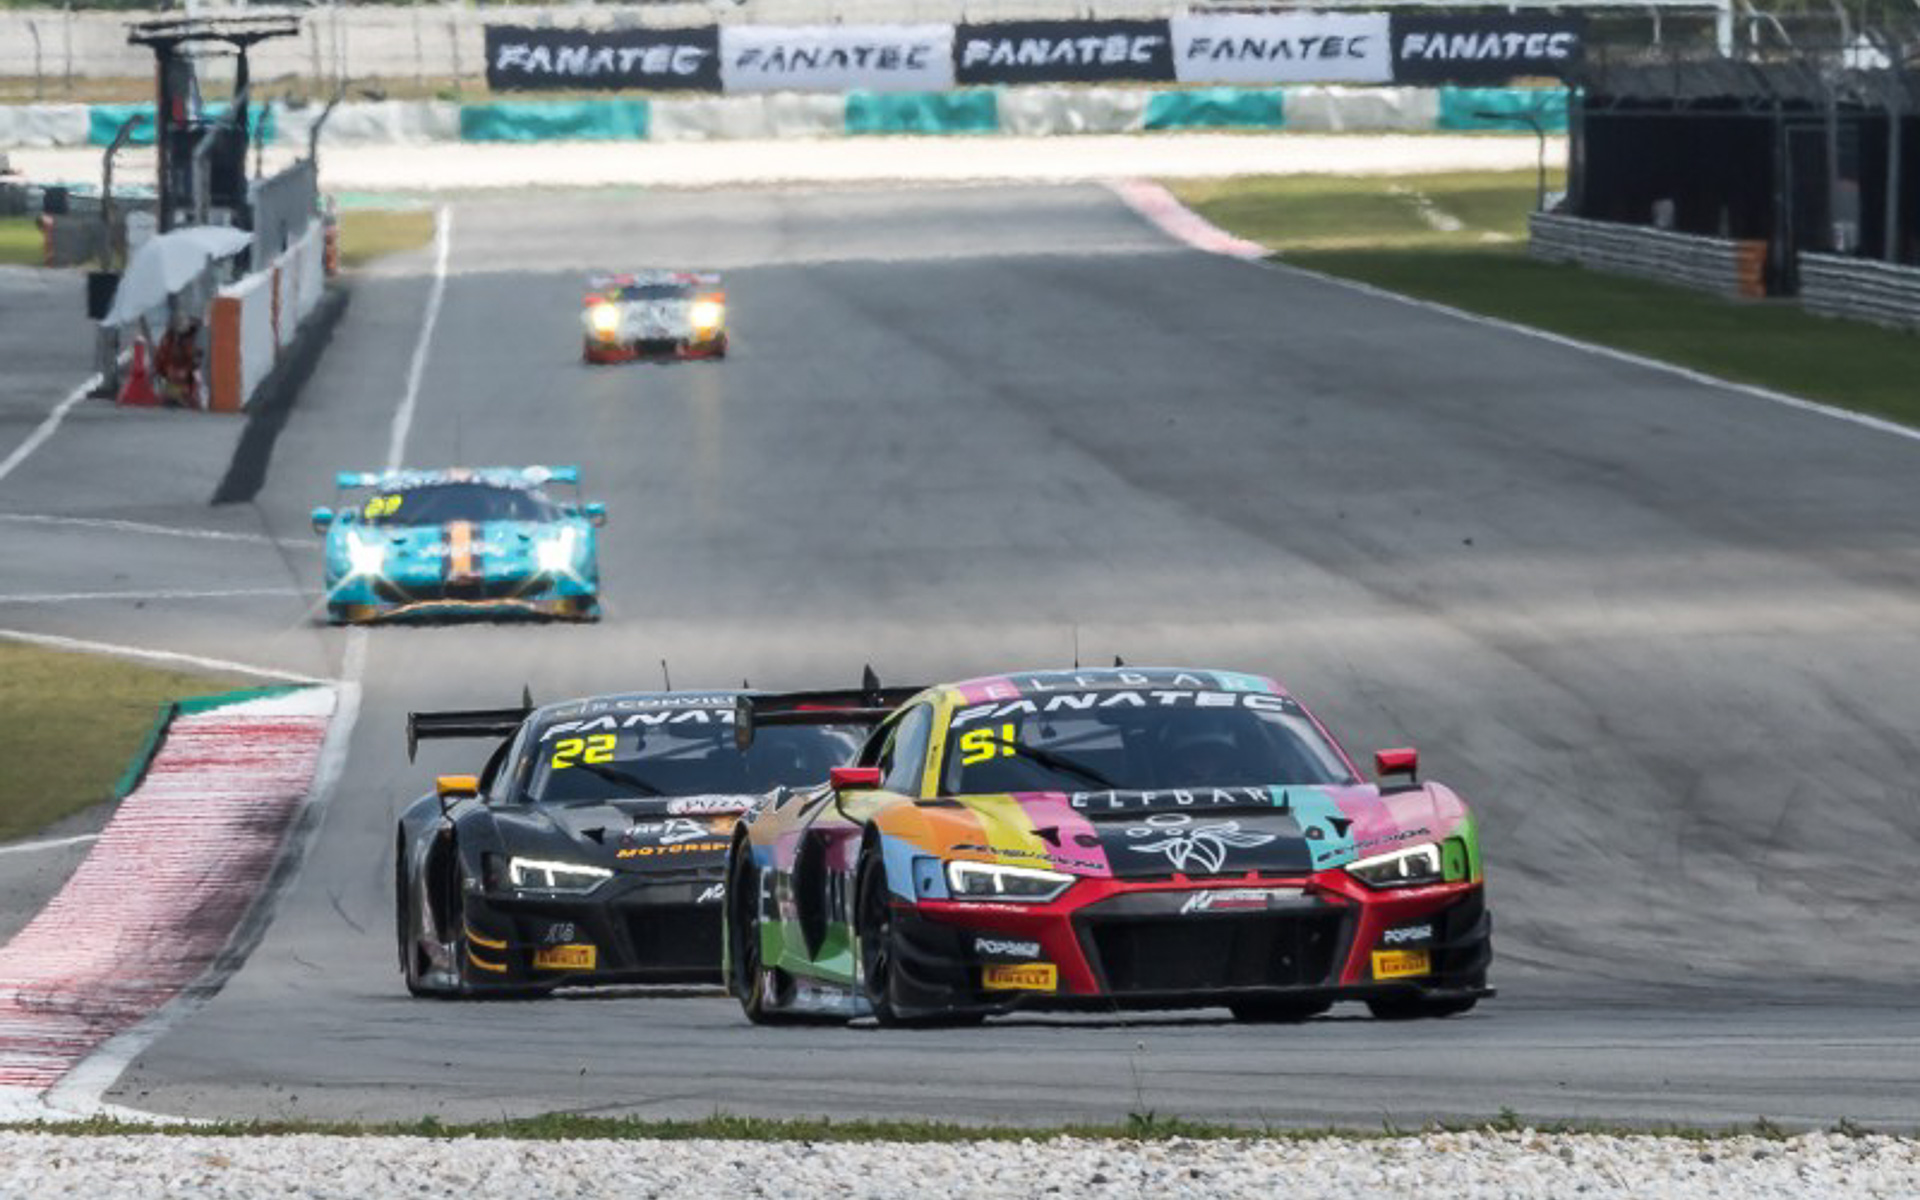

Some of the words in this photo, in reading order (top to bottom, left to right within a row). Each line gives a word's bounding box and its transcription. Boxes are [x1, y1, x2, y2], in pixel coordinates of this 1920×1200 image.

[497, 43, 708, 76] FANATEC
[735, 43, 932, 72] FANATEC
[963, 33, 1164, 68] FANATEC
[1187, 35, 1372, 61] FANATEC
[1401, 32, 1578, 60] FANATEC
[950, 691, 1291, 728] FANATEC
[551, 734, 616, 769] 22
[1072, 786, 1269, 808] ELFBAR
[616, 843, 730, 859] MOTORSP
